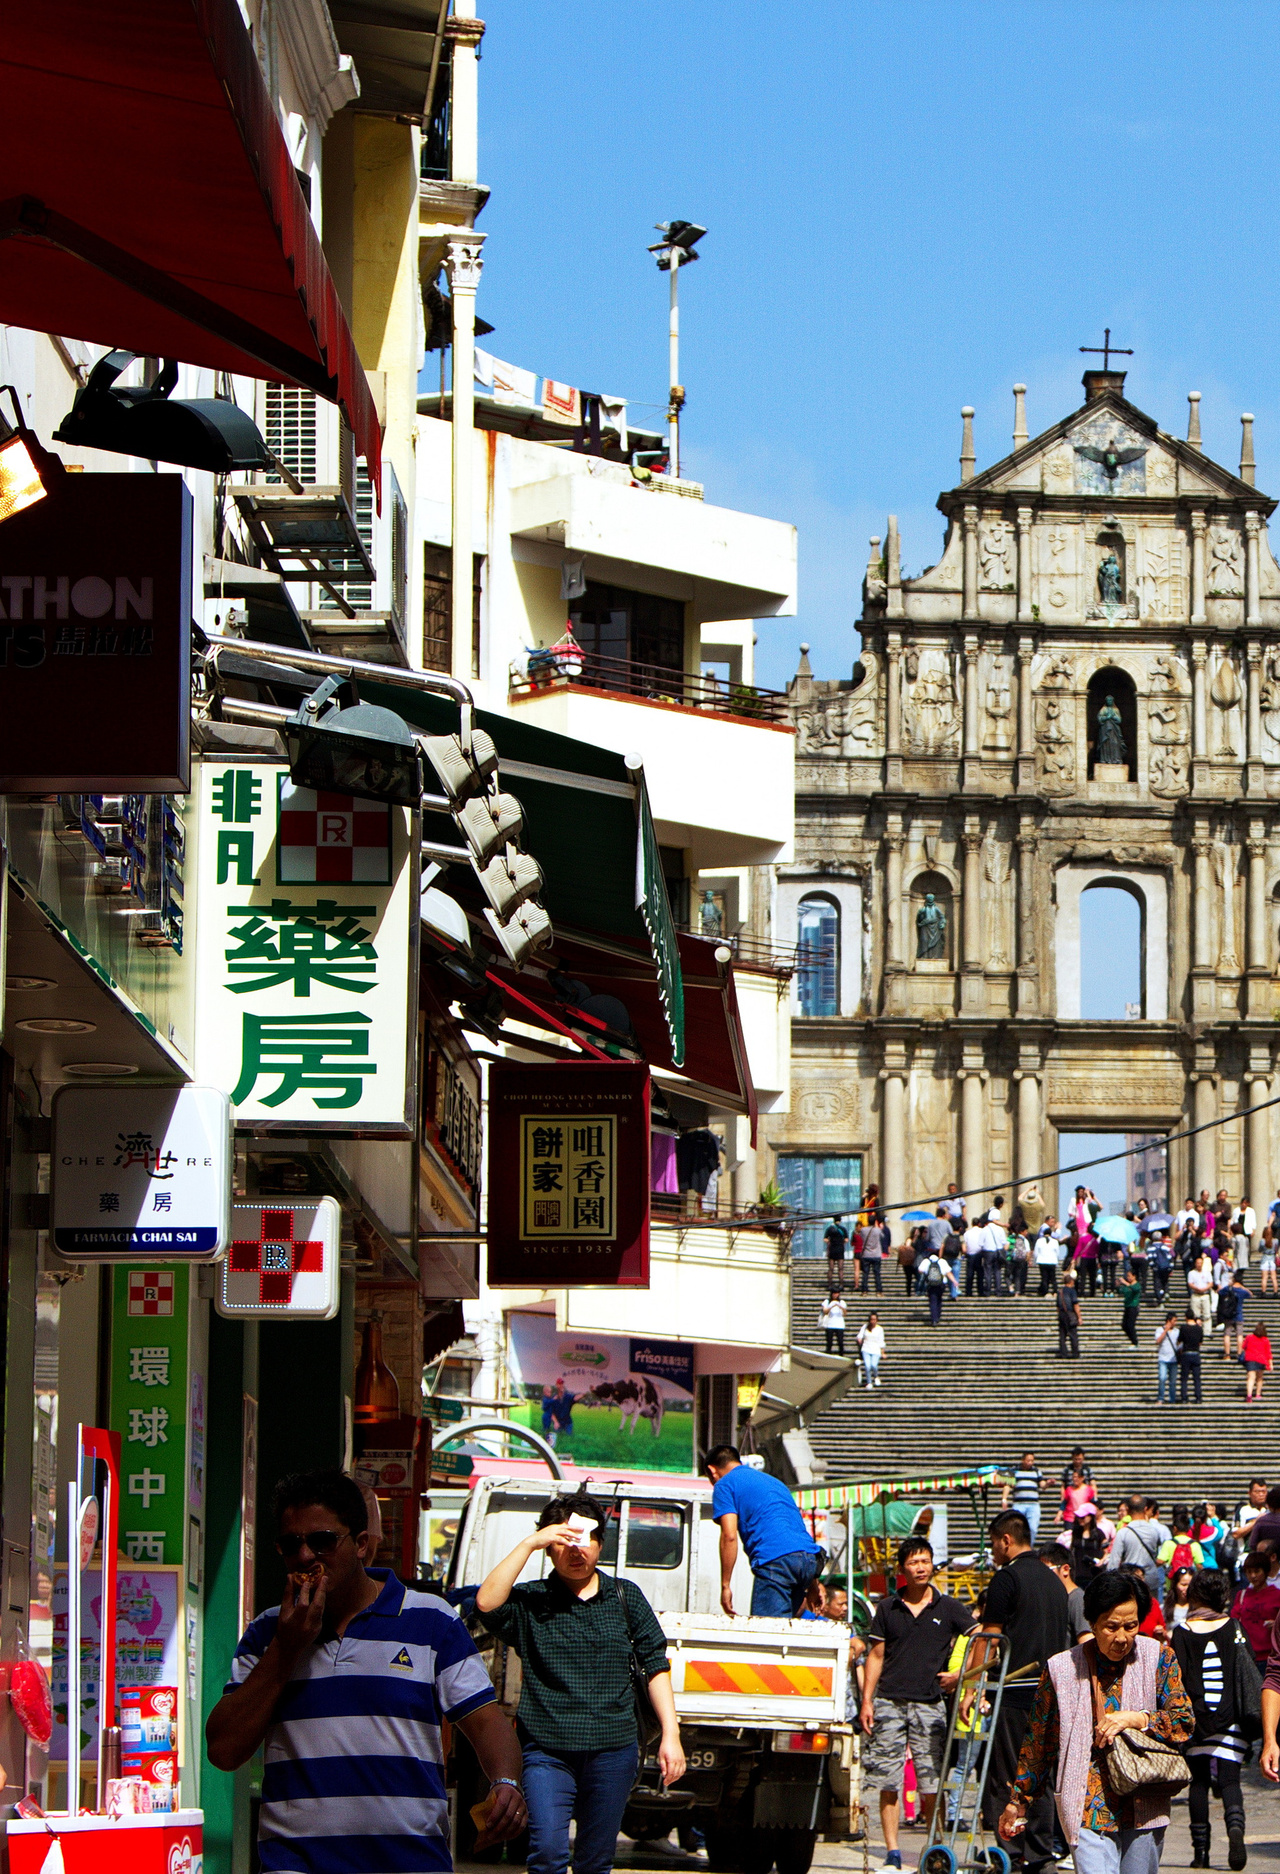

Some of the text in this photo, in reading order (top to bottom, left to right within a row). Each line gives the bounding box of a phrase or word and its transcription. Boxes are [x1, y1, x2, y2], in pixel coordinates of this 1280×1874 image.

[0, 576, 153, 620] THON
[211, 769, 262, 886] 非凡
[224, 899, 378, 1108] 藥房
[531, 1126, 564, 1193] 餅家
[99, 1192, 172, 1213] 藥房
[142, 1231, 173, 1243] CHAI
[176, 1231, 198, 1243] SAI
[524, 1245, 612, 1254] SINCE 1935
[634, 1350, 662, 1365] Friso
[125, 1347, 170, 1564] 環球中西
